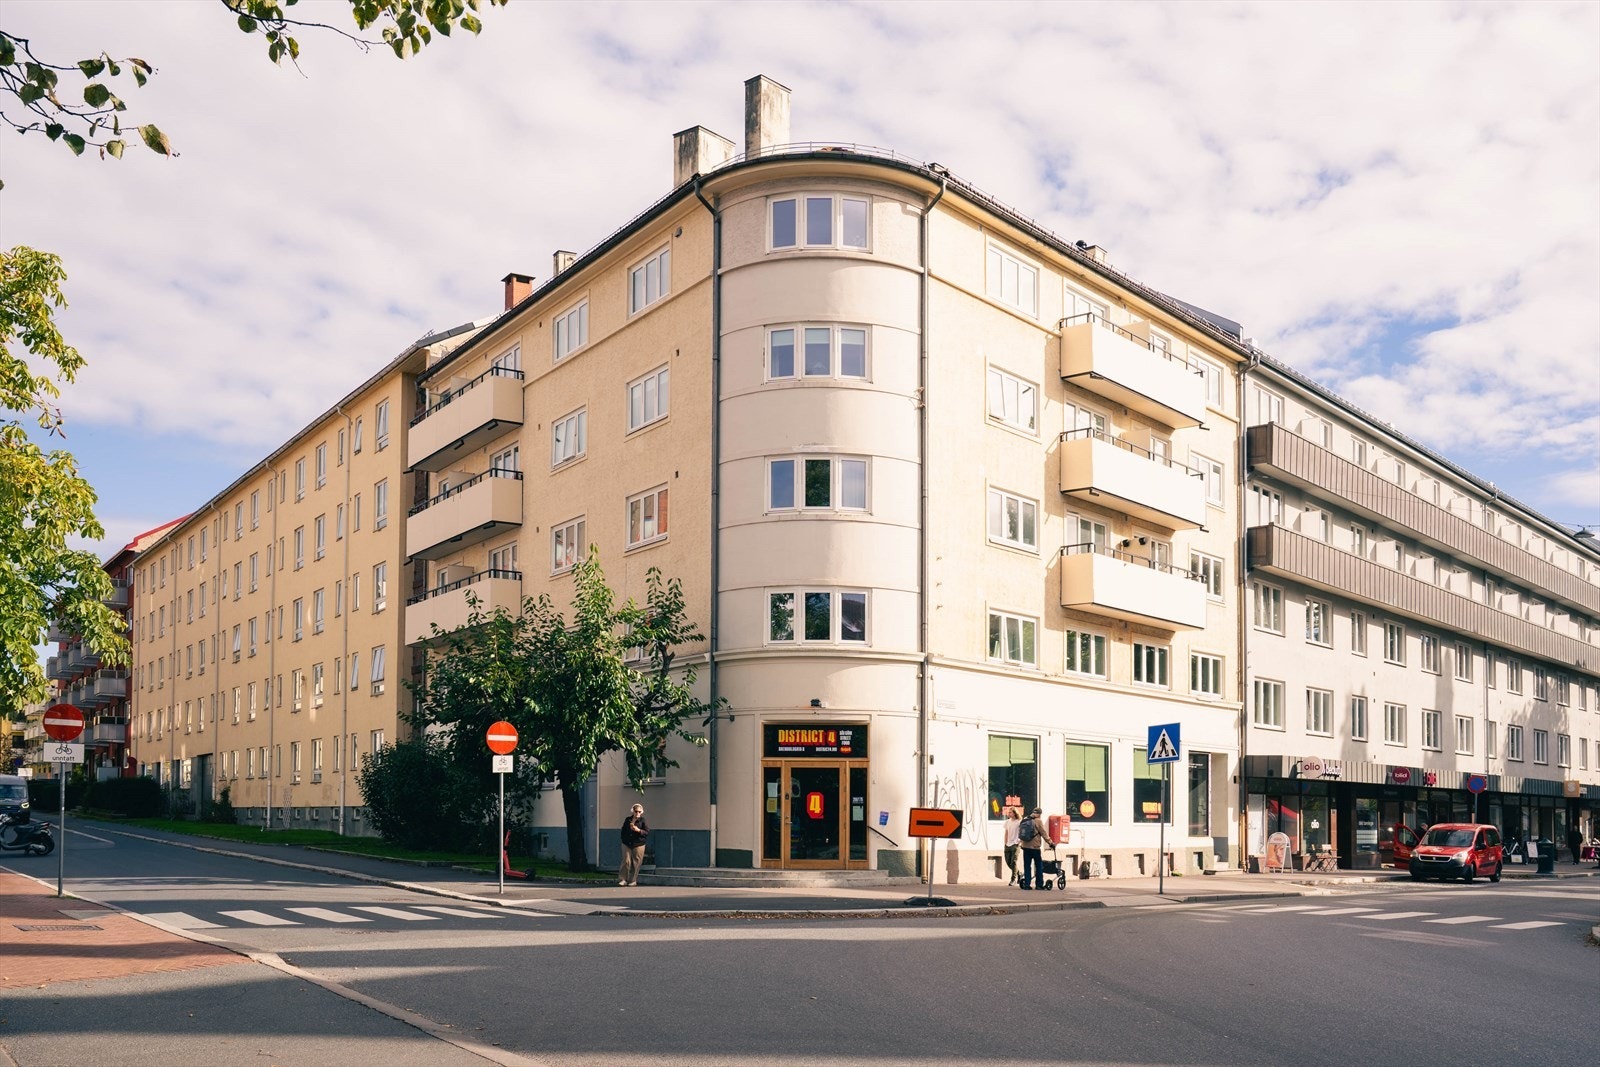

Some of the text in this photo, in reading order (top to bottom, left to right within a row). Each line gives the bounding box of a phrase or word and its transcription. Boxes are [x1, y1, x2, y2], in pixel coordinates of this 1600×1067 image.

[778, 729, 825, 743] DISTRICT
[1304, 762, 1320, 770] olio
[810, 795, 821, 813] 4
